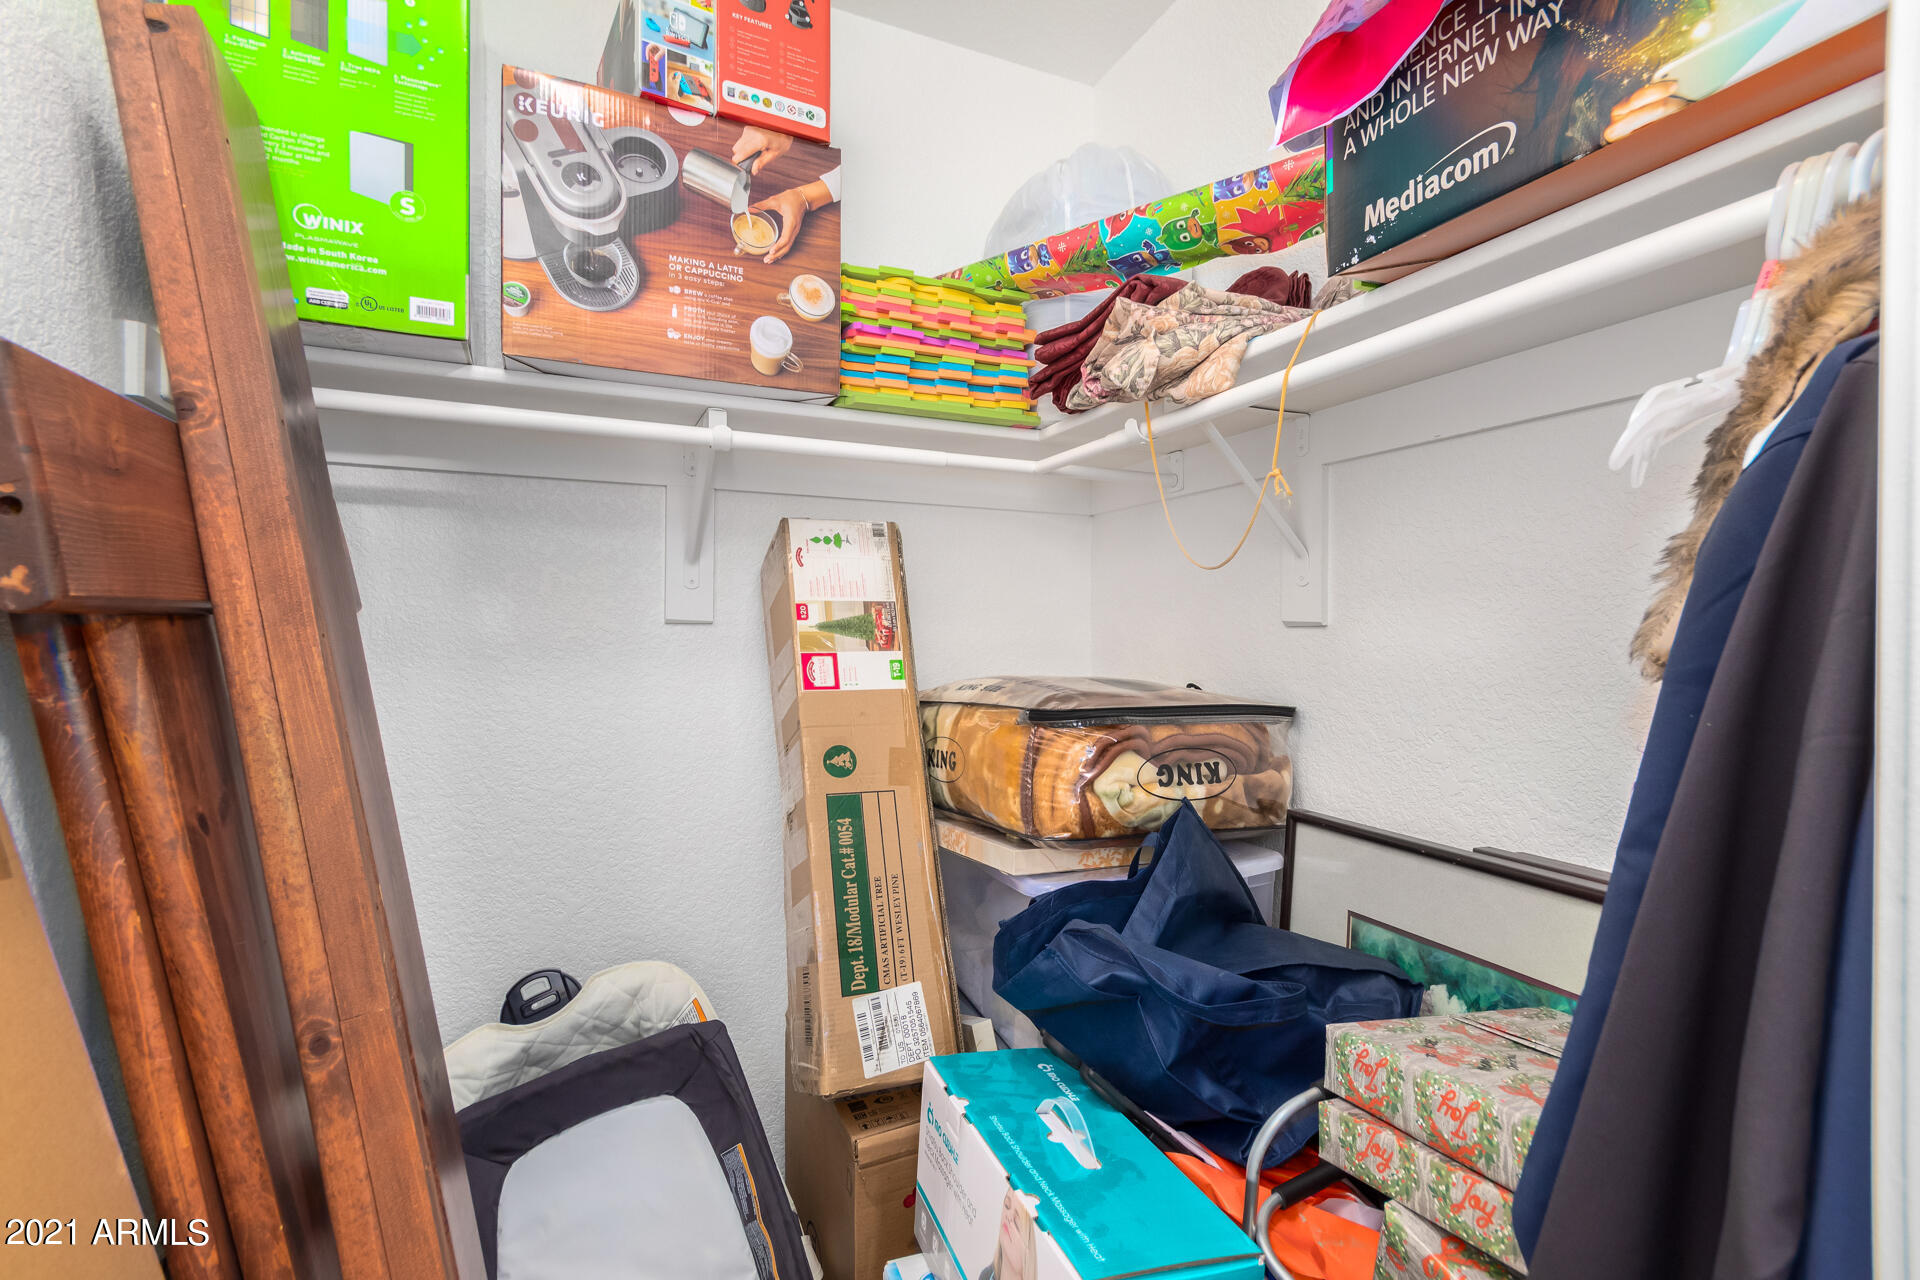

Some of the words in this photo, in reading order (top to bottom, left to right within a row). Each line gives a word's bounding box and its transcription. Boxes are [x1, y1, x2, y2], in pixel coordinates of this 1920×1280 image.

[732, 12, 743, 21] KEY
[744, 17, 772, 30] FEATURES
[1344, 92, 1384, 136] AND
[1391, 7, 1502, 103] INTERNET
[1344, 137, 1356, 161] A
[1360, 80, 1436, 147] WHOLE
[1443, 37, 1500, 96] NEW
[1506, 0, 1563, 52] WAY
[518, 95, 605, 128] KEURIG
[1364, 141, 1499, 231] Mediacom
[400, 197, 416, 217] S
[303, 212, 364, 236] WINIX
[307, 246, 317, 255] in
[319, 248, 348, 259] South
[349, 253, 379, 265] Korea
[669, 254, 706, 268] MAKING
[717, 263, 744, 275] LATTE
[669, 263, 682, 272] OR
[685, 266, 744, 283] CAPPUCCINO
[684, 276, 702, 284] easy
[704, 278, 725, 287] steps:
[684, 289, 704, 297] BREW
[684, 333, 705, 341] ENJOY
[927, 748, 957, 771] KING
[1157, 761, 1222, 788] KING
[837, 818, 854, 845] 0054
[839, 847, 857, 879] Cat.#
[874, 876, 883, 900] TREE
[891, 873, 900, 895] PINE
[843, 881, 864, 954] 18/Modular
[894, 897, 903, 934] WESLEY
[877, 902, 889, 956] ARTIFICIAL
[851, 955, 869, 992] Dept.
[882, 958, 891, 985] CMAS
[899, 956, 908, 982] (T-19)
[898, 1041, 905, 1053] US
[901, 1055, 907, 1065] TO
[906, 1042, 916, 1063] DEPT
[915, 1048, 922, 1061] PO
[920, 1042, 931, 1058] ITEM
[1353, 1048, 1389, 1094] Joy
[1437, 1089, 1482, 1141] Joy
[1356, 1125, 1395, 1174] Joy
[1011, 1145, 1033, 1169] Shoulder
[1029, 1168, 1043, 1181] and
[1038, 1181, 1056, 1198] Neck
[1052, 1197, 1079, 1229] Massager
[1076, 1229, 1090, 1244] with
[1087, 1243, 1106, 1262] Heat
[1450, 1174, 1498, 1230] Joy
